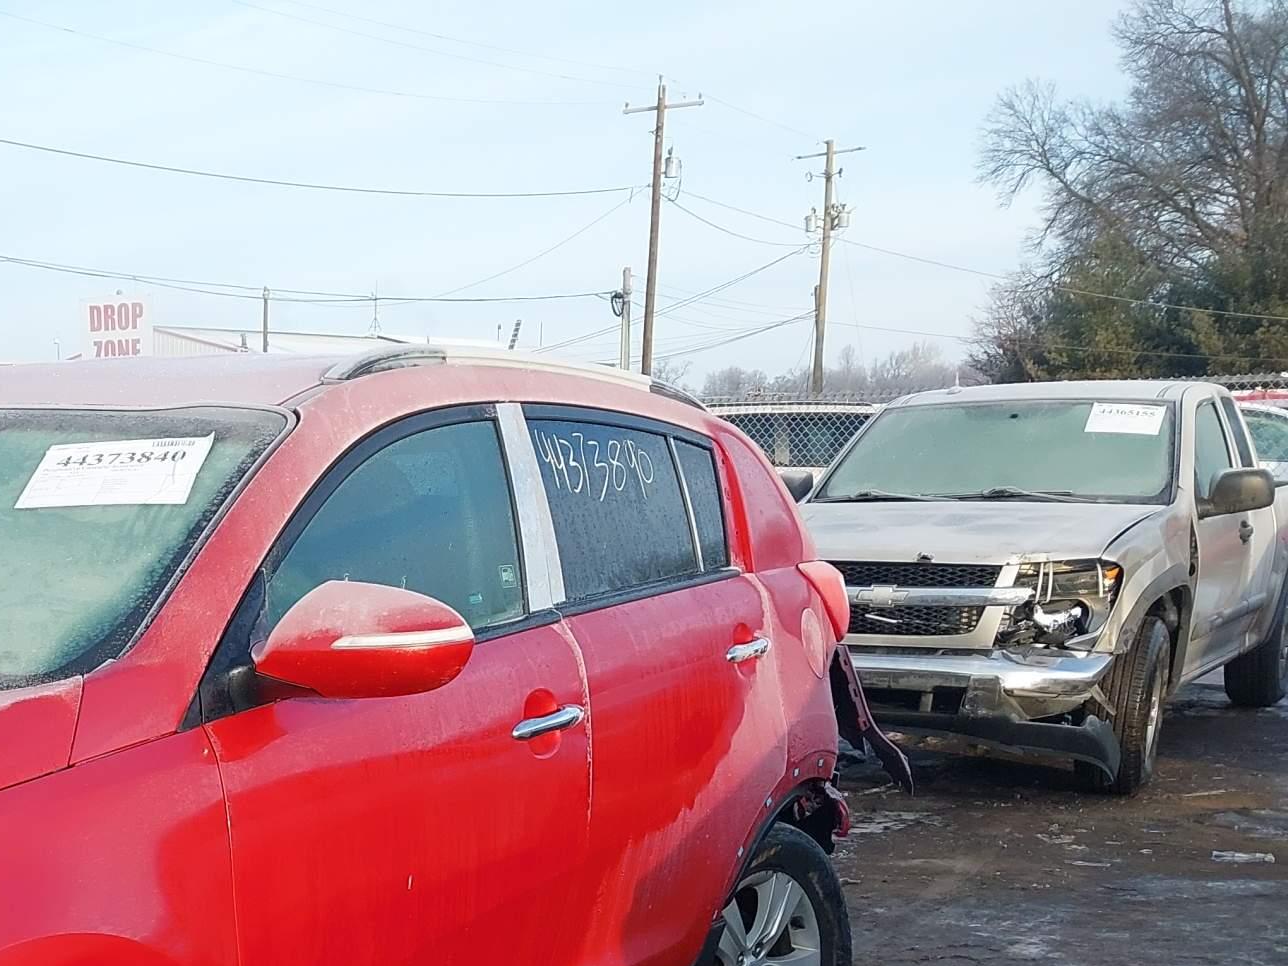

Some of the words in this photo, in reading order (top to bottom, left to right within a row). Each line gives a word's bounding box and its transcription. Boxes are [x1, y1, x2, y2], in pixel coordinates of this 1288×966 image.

[88, 302, 144, 332] DROP
[93, 338, 140, 358] ZONE
[56, 450, 188, 467] 44373840
